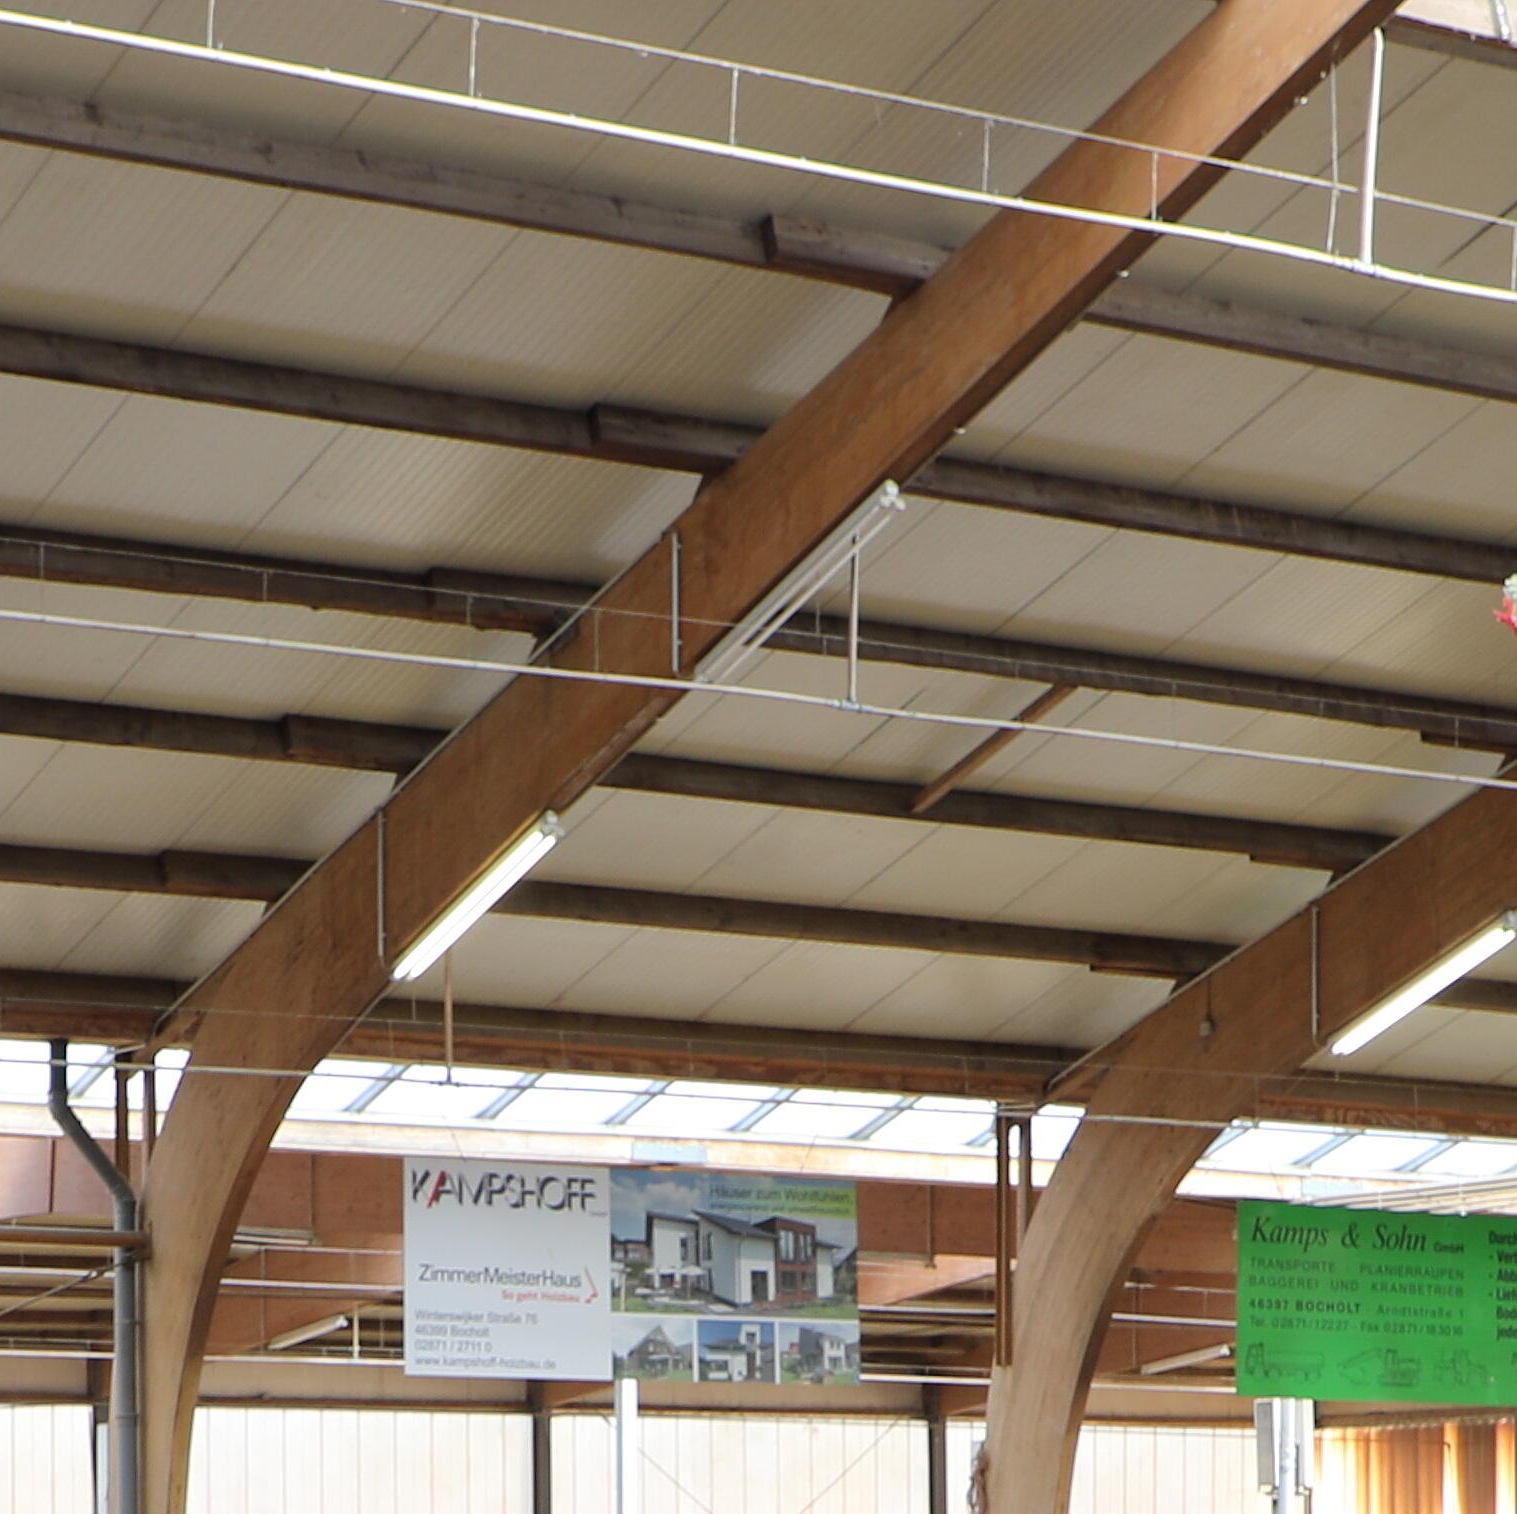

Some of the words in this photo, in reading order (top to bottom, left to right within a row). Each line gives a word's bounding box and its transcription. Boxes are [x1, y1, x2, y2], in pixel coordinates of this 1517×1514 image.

[411, 1168, 597, 1211] KAMPSHOFF
[1251, 1216, 1329, 1252] Kamps
[1341, 1221, 1360, 1248] &
[1373, 1223, 1427, 1251] Sohn
[1250, 1257, 1334, 1273] TRANSPORTE
[418, 1263, 582, 1288] ZimmerMeisterHaus
[1248, 1275, 1319, 1290] BAGGEREI
[1330, 1279, 1359, 1292] UND
[1371, 1282, 1464, 1297] KRANBETRIEB
[1295, 1301, 1361, 1314] BOCHOLT
[487, 1311, 522, 1324] Straße
[450, 1326, 490, 1337] Bocholt
